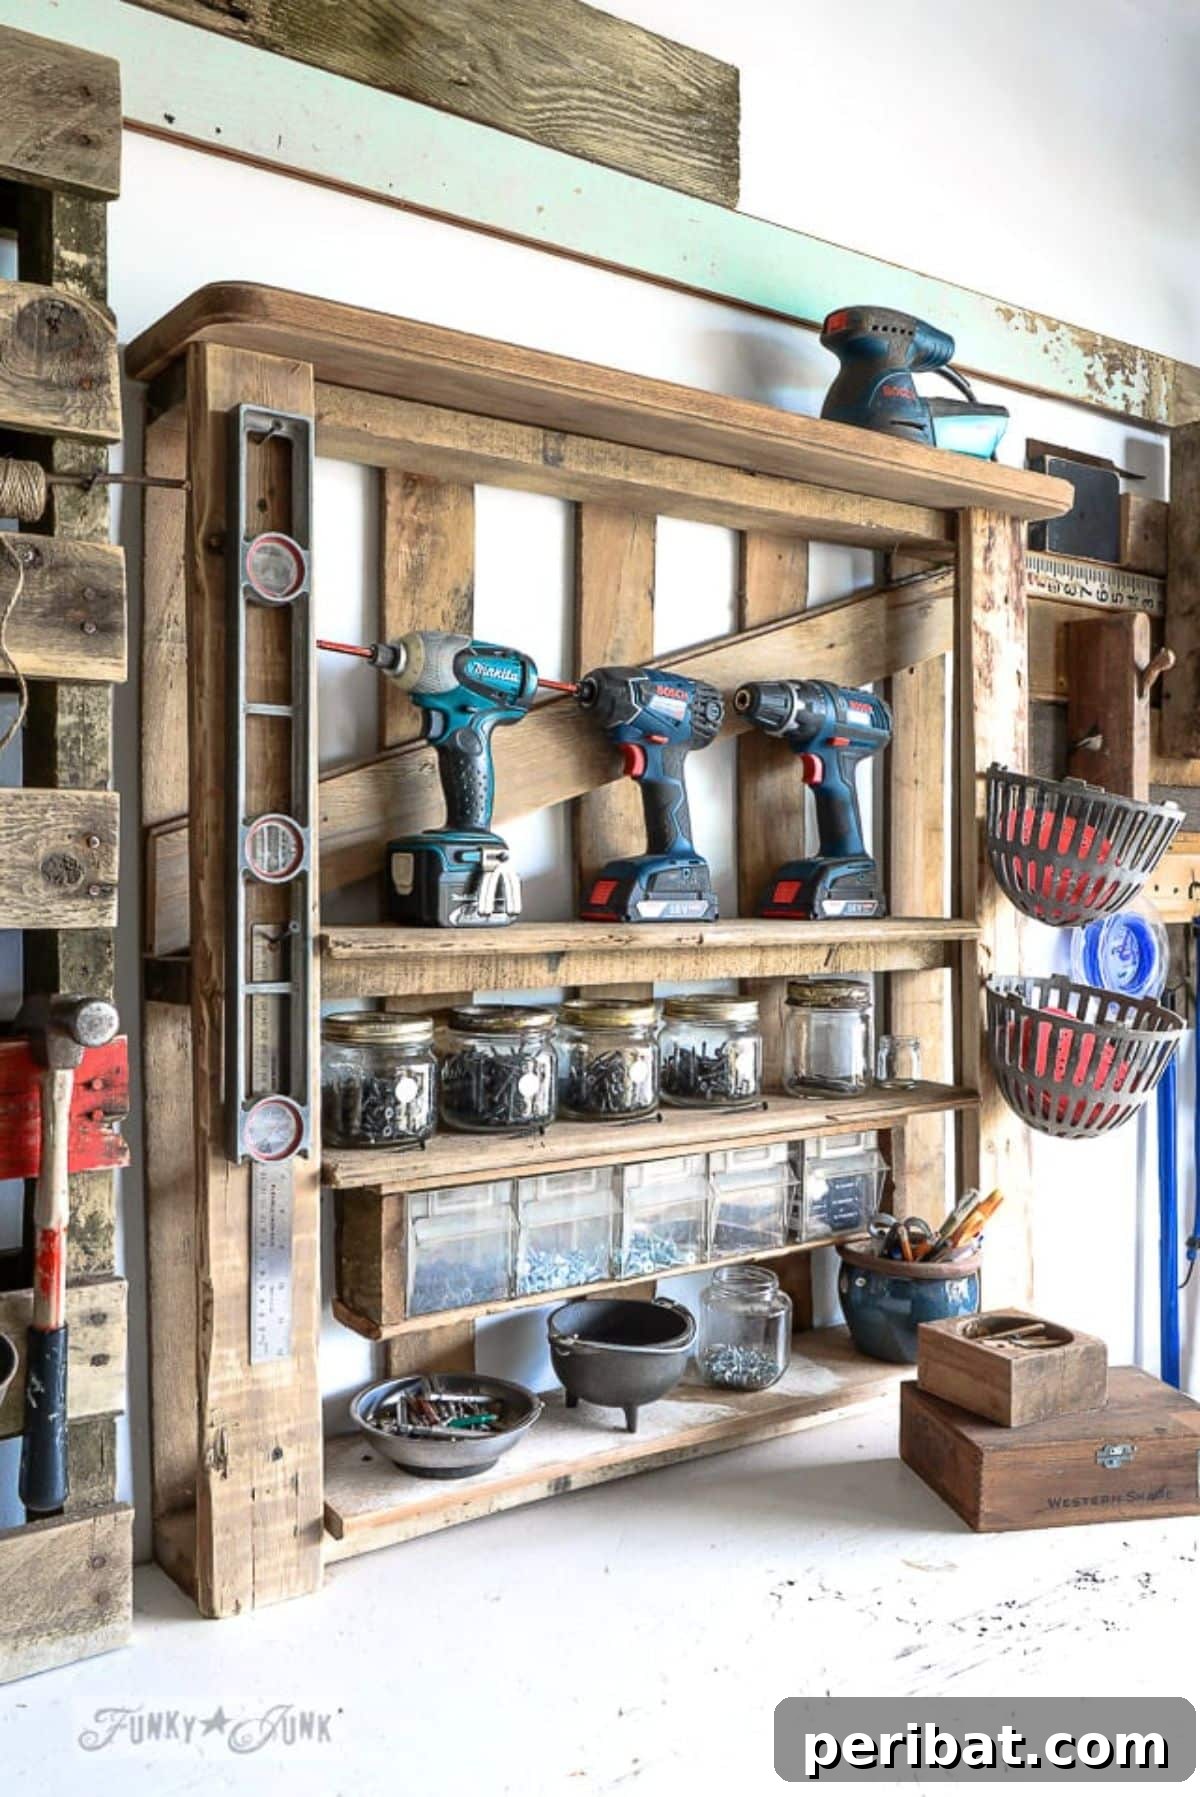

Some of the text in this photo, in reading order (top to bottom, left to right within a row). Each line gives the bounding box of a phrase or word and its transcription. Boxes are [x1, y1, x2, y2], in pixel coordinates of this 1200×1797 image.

[1096, 588, 1109, 602] 6
[472, 661, 519, 682] Makita
[655, 685, 689, 701] BOSCH
